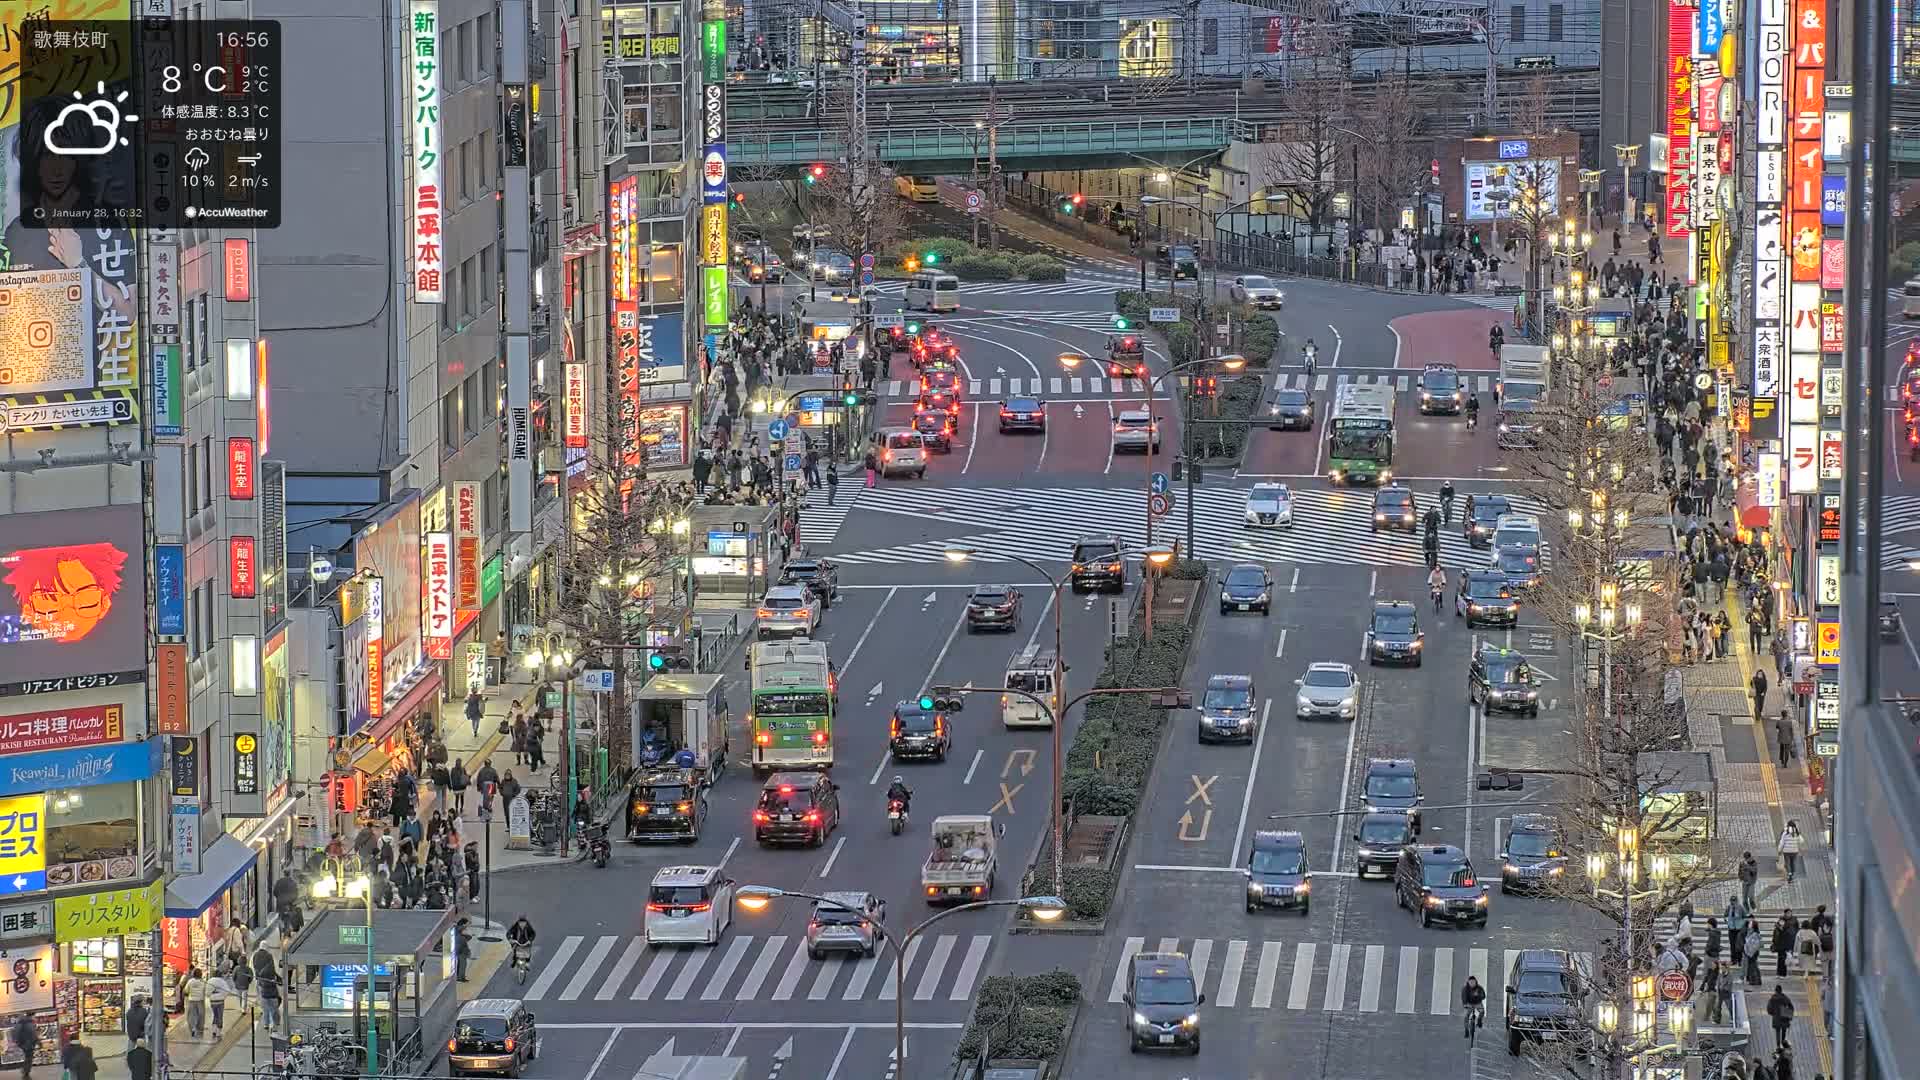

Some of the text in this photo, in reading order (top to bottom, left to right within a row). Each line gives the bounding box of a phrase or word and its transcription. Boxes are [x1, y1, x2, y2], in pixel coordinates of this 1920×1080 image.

[1705, 0, 1717, 46] ントラル
[651, 36, 679, 55] 夜間
[706, 85, 721, 139] もつなべ
[1703, 87, 1716, 120] アコム
[414, 11, 440, 293] 新宿サンパーク 三平本館
[1671, 55, 1692, 232] パチンコ エスパス
[706, 161, 722, 177] 薬
[1767, 153, 1775, 200] ESOLA
[709, 208, 721, 263] 肉汁水餃子
[708, 276, 721, 313] レイク
[156, 324, 174, 334] 3F
[618, 331, 636, 388] ラーメン
[1757, 330, 1772, 382] 大衆酒場
[154, 354, 168, 416] FamilyMart
[1793, 308, 1818, 469] パセラ
[12, 404, 111, 424] テンクリ たいせい先生
[1827, 405, 1840, 415] 5F
[513, 407, 526, 460] HOMEGAME
[234, 450, 248, 488] 龍生堂
[459, 487, 470, 532] GAME
[1826, 497, 1838, 506] 3F
[160, 556, 171, 606] ゲウチャイ
[236, 548, 249, 583] 龍生堂
[431, 543, 448, 630] 三平ストア
[22, 674, 119, 694] リアエイド ビジョン
[68, 718, 104, 731] パムッカレ
[108, 712, 118, 736] 5F
[23, 736, 68, 748] RESTAURANT
[0, 811, 39, 835] プロ
[0, 836, 39, 858] ミス
[3, 911, 38, 932] 囲碁
[68, 903, 141, 927] クリスタル
[330, 963, 382, 972] SUBNAE
[1663, 980, 1686, 991] 消火栓
